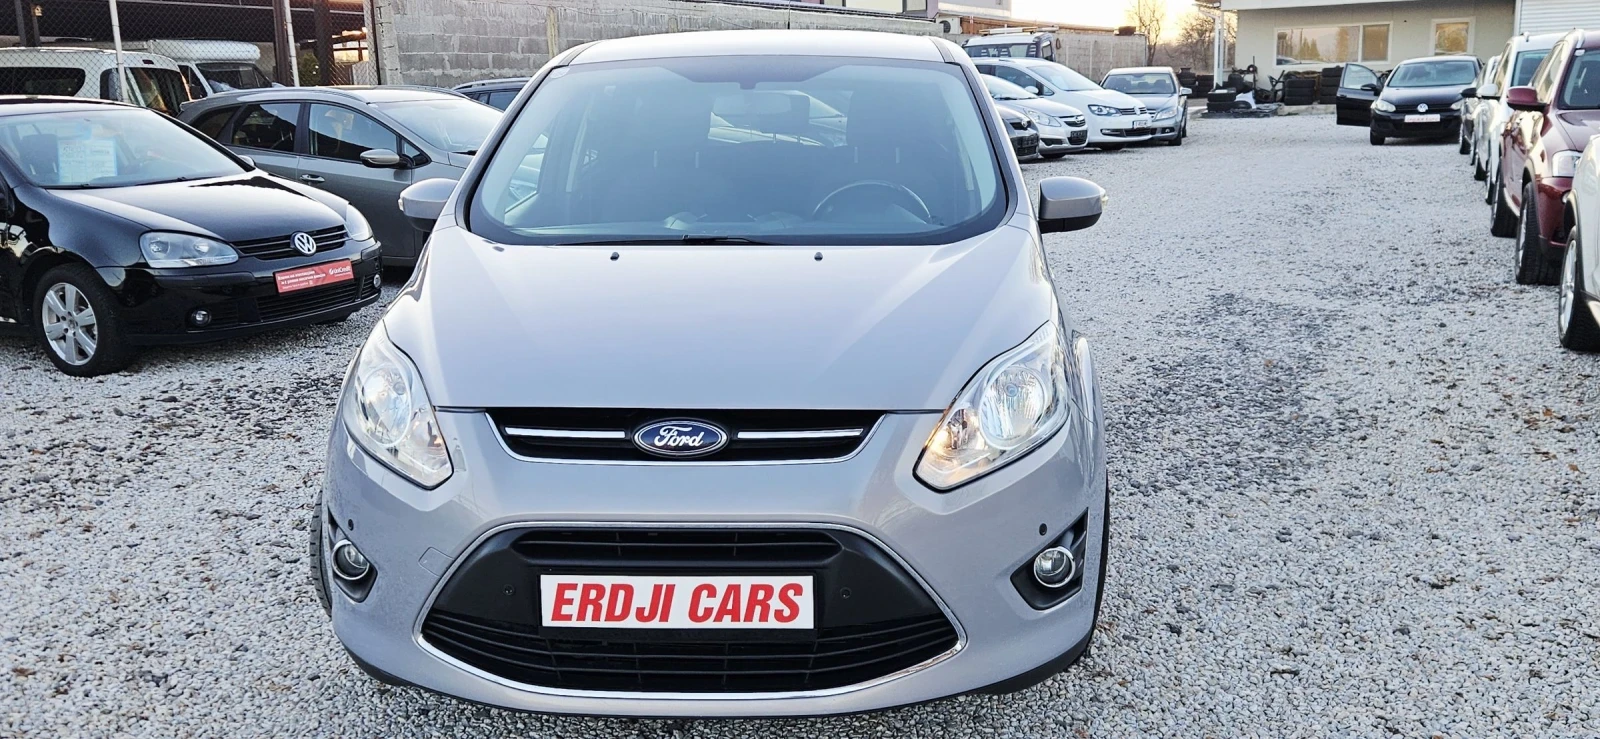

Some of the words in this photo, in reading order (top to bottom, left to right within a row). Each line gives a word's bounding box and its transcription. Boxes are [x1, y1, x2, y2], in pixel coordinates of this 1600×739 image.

[654, 426, 704, 446] Ford
[551, 583, 676, 622] ERDJI
[688, 583, 804, 623] CARS
